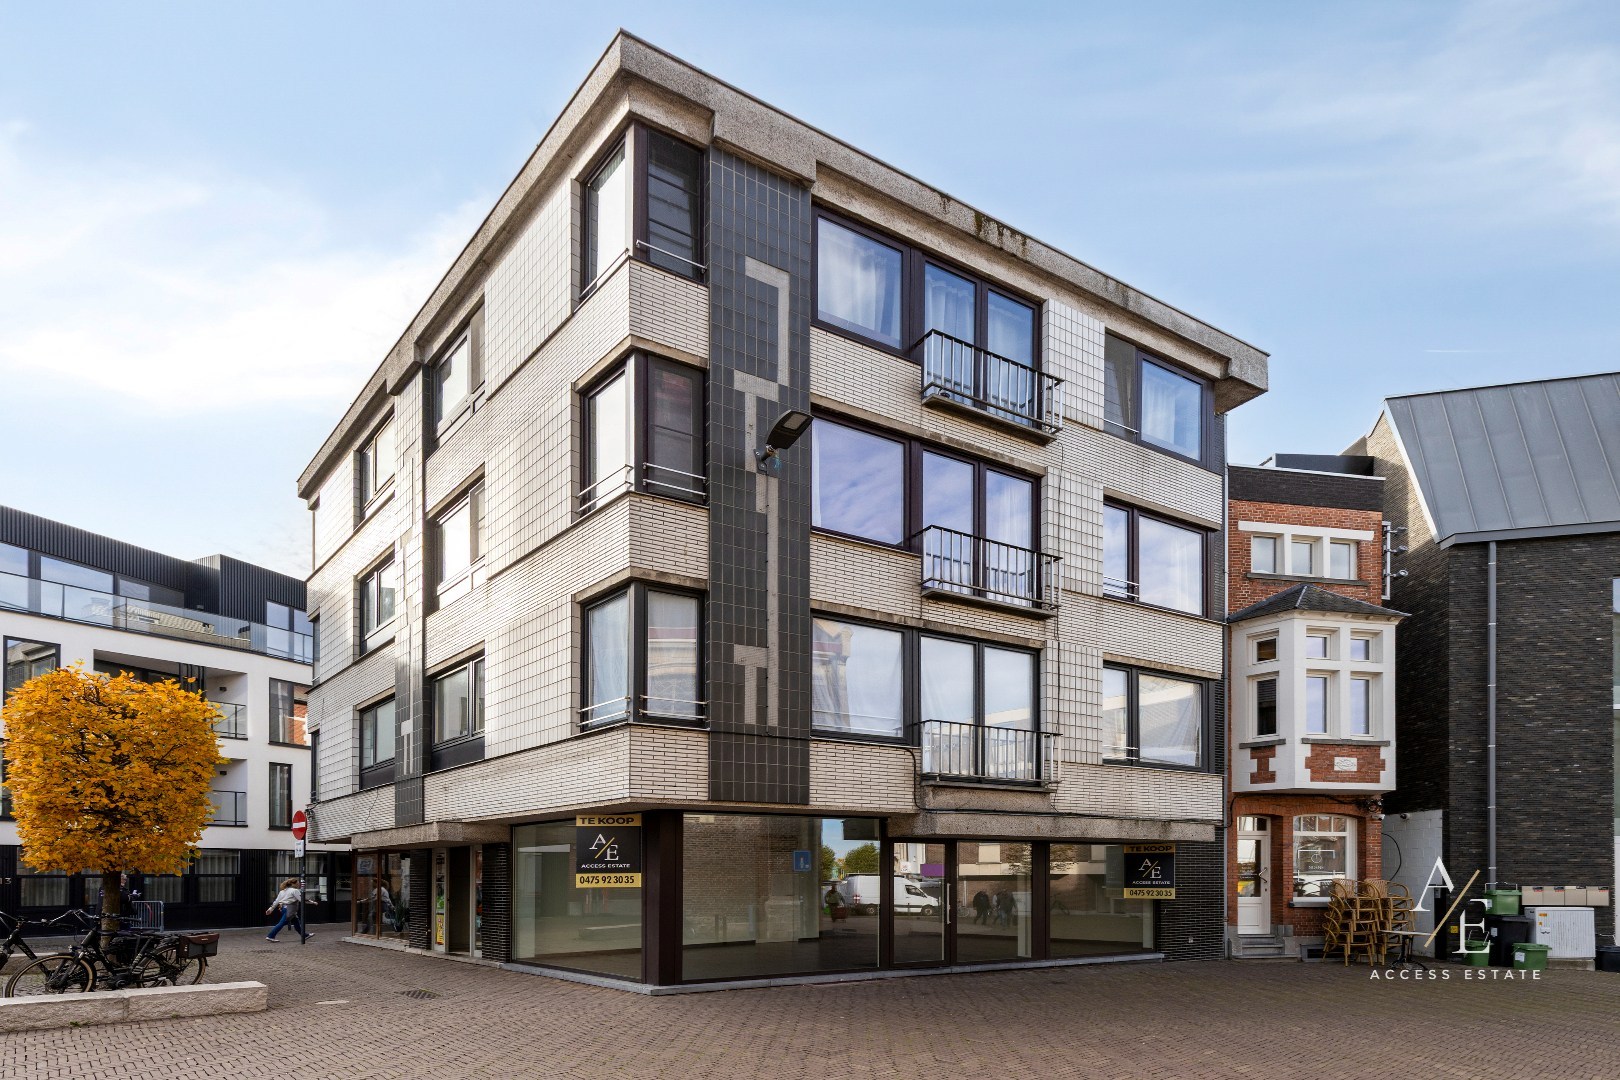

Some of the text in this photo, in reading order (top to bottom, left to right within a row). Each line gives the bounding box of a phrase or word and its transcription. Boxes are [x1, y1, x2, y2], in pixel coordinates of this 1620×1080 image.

[580, 817, 635, 825] TE KOOP
[579, 875, 635, 885] 0475 92 30 35
[1129, 889, 1173, 897] 0475 92 30 35
